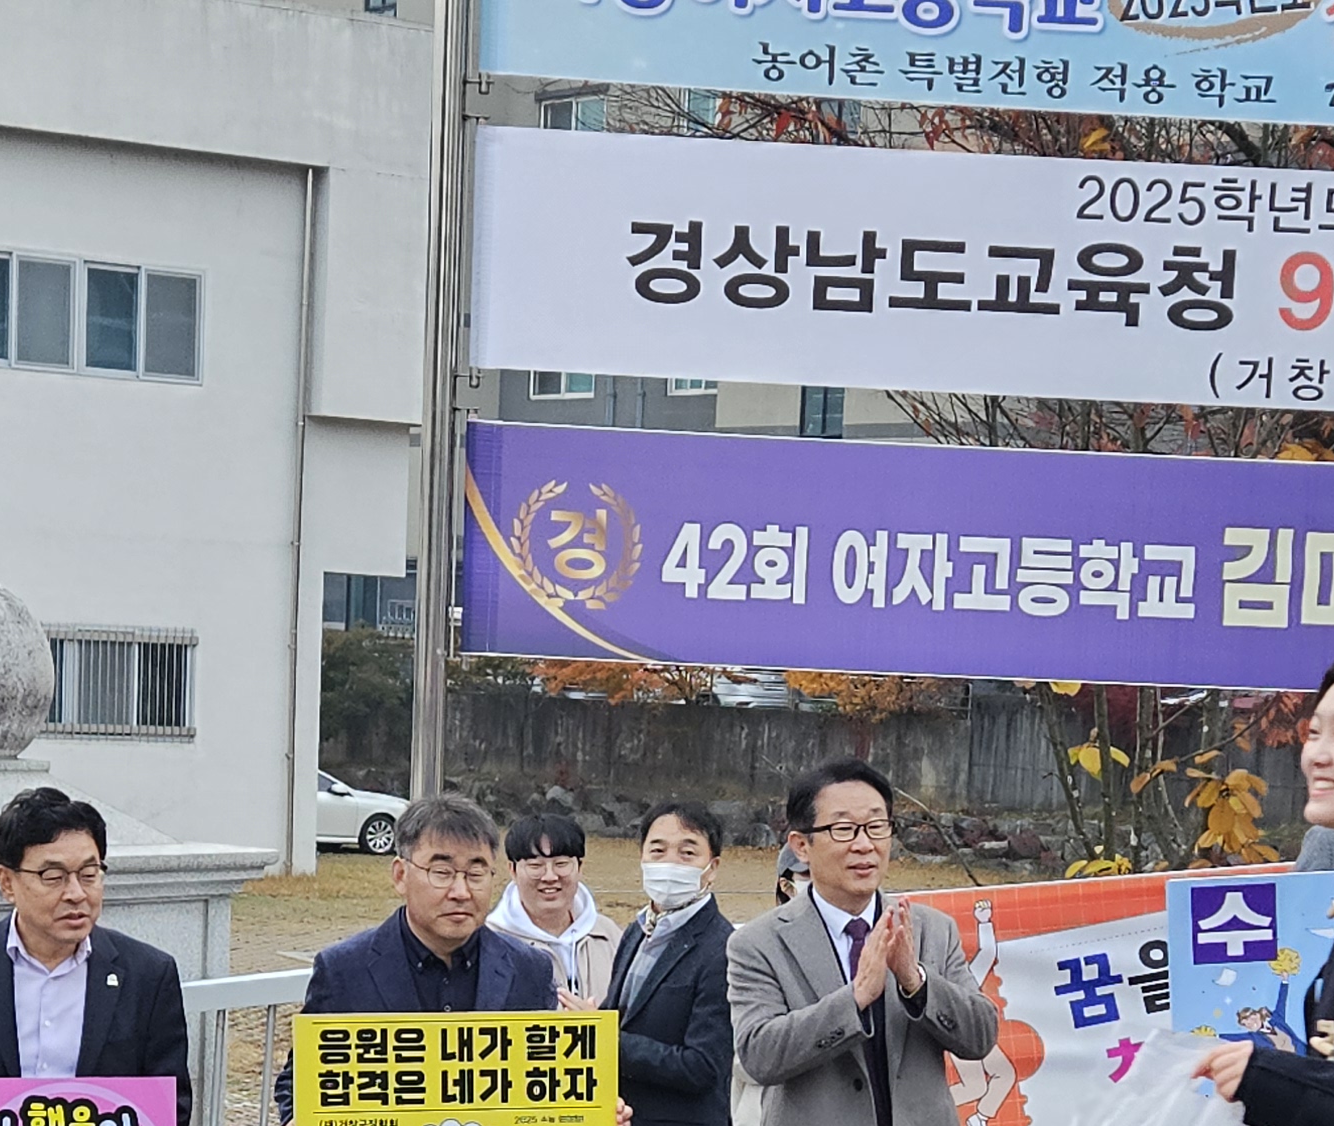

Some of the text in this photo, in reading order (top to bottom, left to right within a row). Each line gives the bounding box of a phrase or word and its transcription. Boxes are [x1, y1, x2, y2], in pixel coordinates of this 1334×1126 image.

[752, 41, 885, 87] 농어촌
[899, 51, 1070, 99] 특별전형
[1089, 62, 1177, 105] 적용
[1191, 67, 1277, 109] 학교
[626, 220, 1238, 332] 경상남도교육청
[547, 508, 607, 580] 경
[661, 521, 809, 605] 42회
[831, 529, 1196, 621] 여자고등학교
[1197, 891, 1273, 957] 수
[318, 1024, 597, 1065] 응원은 내가 할게
[318, 1067, 598, 1107] 합격은 네가 하자
